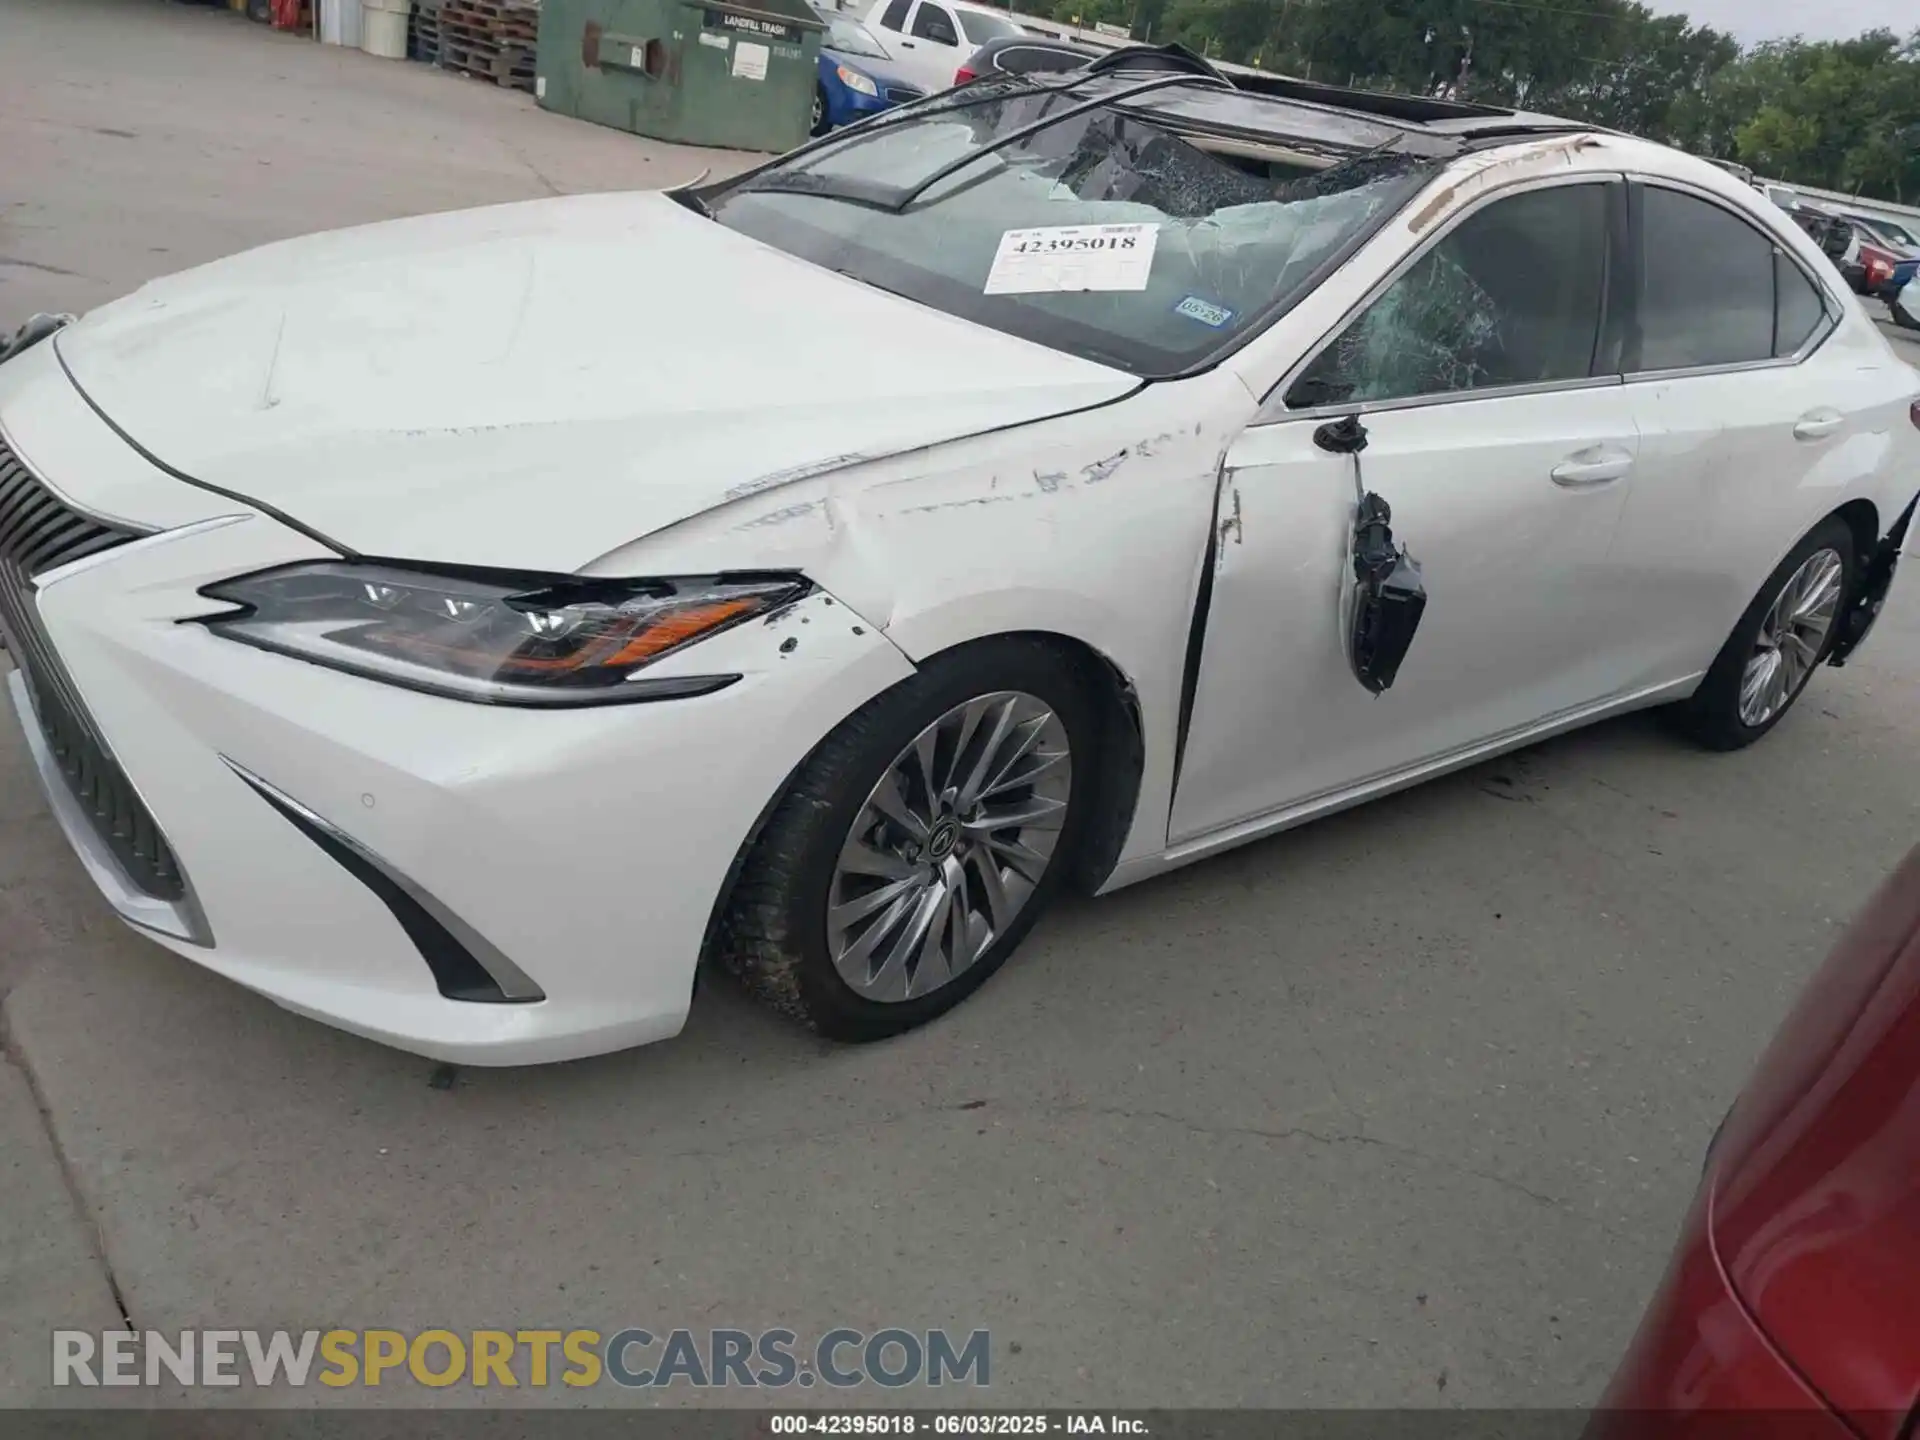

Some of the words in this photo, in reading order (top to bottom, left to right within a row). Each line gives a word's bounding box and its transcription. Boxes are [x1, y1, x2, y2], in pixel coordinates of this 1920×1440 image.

[724, 15, 760, 31] LANDFILL
[761, 22, 786, 36] TRASH
[1013, 236, 1136, 253] 42395018
